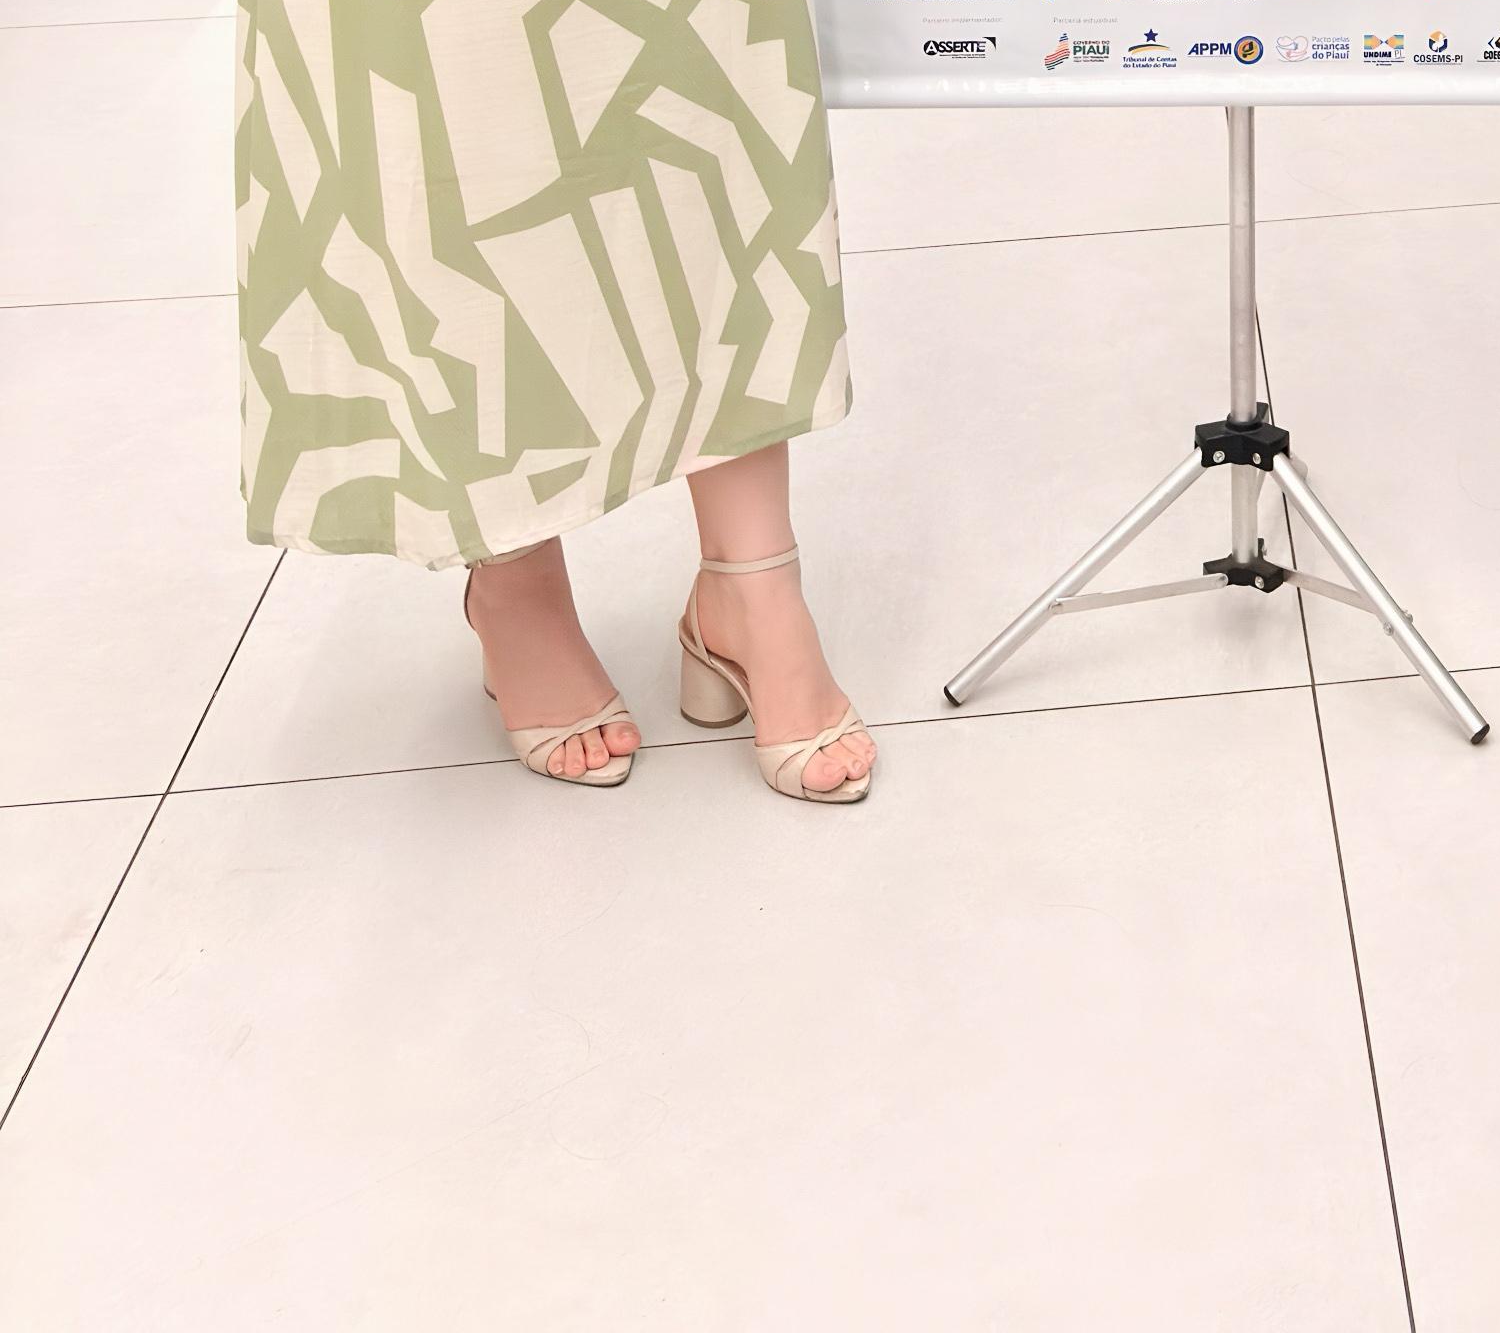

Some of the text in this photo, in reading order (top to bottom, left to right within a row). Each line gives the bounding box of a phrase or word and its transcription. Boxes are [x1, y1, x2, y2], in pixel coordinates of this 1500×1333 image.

[924, 40, 986, 56] ASSERTE
[1188, 43, 1232, 55] APPM
[1312, 43, 1350, 51] crianças
[1312, 51, 1350, 59] do Piauí
[1413, 54, 1463, 63] COSEMS-PI
